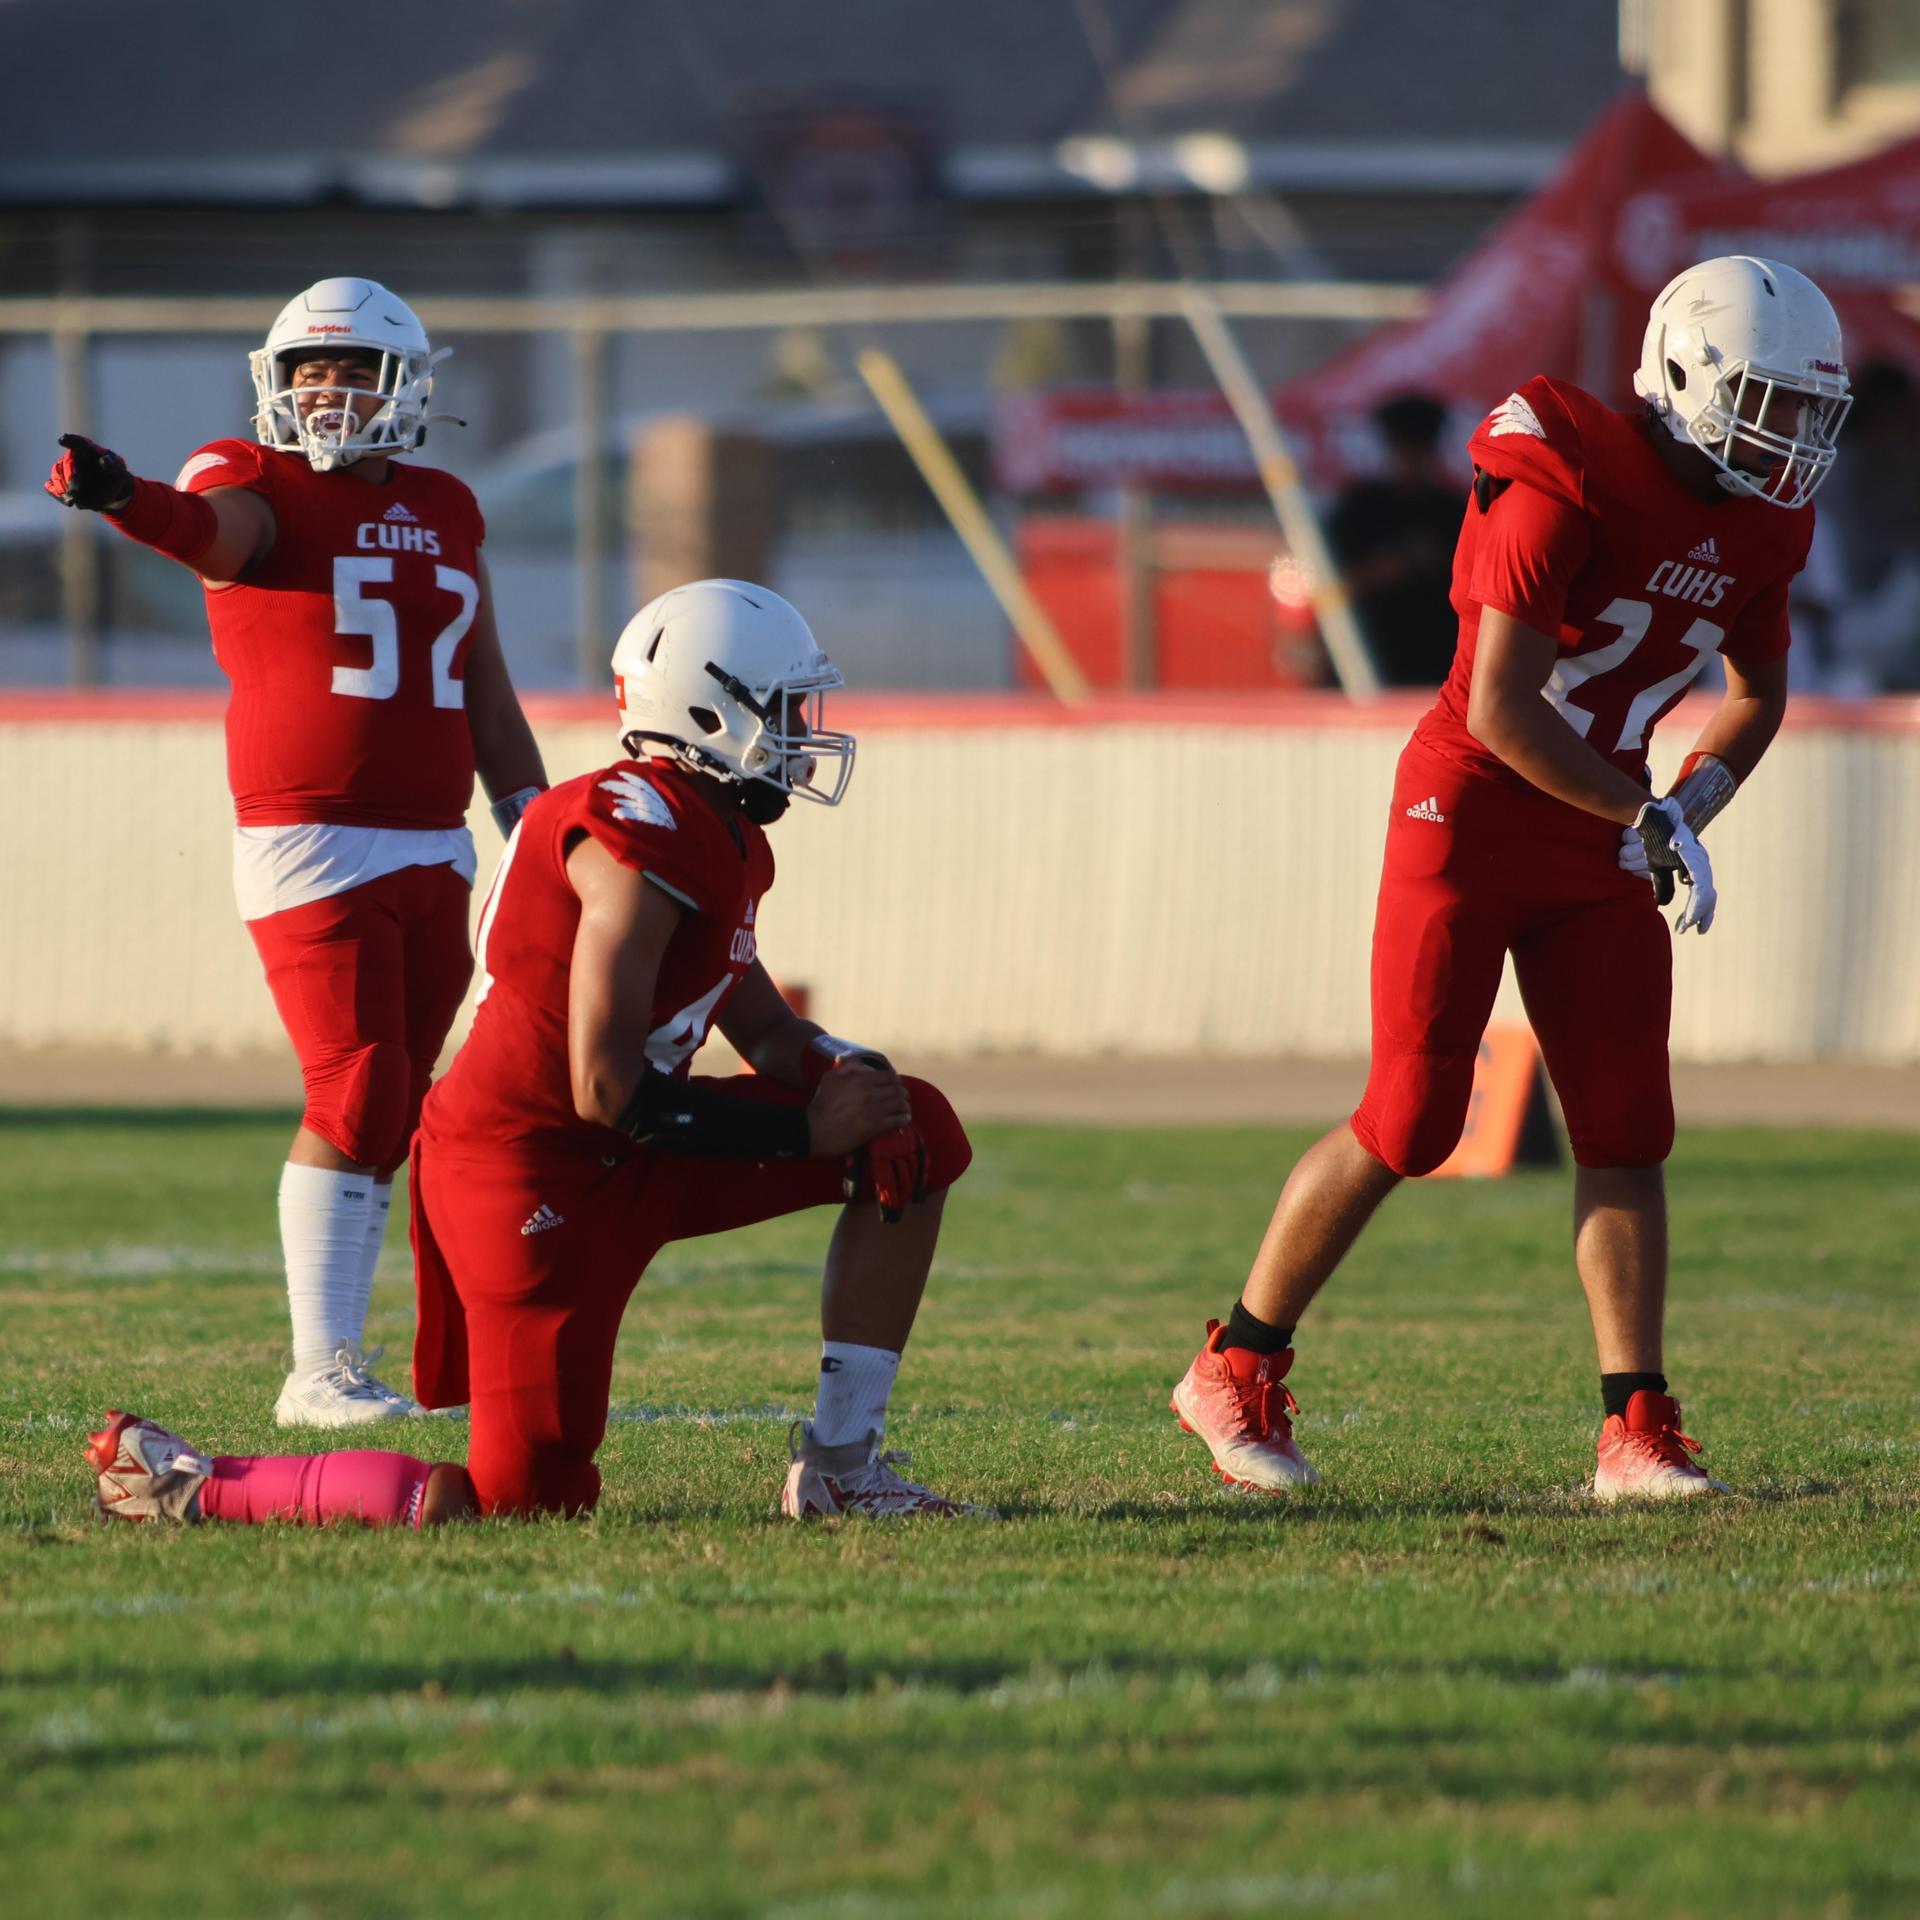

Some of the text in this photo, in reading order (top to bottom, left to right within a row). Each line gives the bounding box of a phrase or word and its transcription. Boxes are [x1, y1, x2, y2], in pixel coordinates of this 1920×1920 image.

[356, 522, 441, 556] CUHS
[1687, 547, 1721, 564] adidas
[1645, 560, 1737, 608] CUHS
[330, 556, 480, 710] 52
[1406, 807, 1445, 823] adidas
[643, 972, 743, 1081] 4
[520, 1215, 565, 1236] adidas
